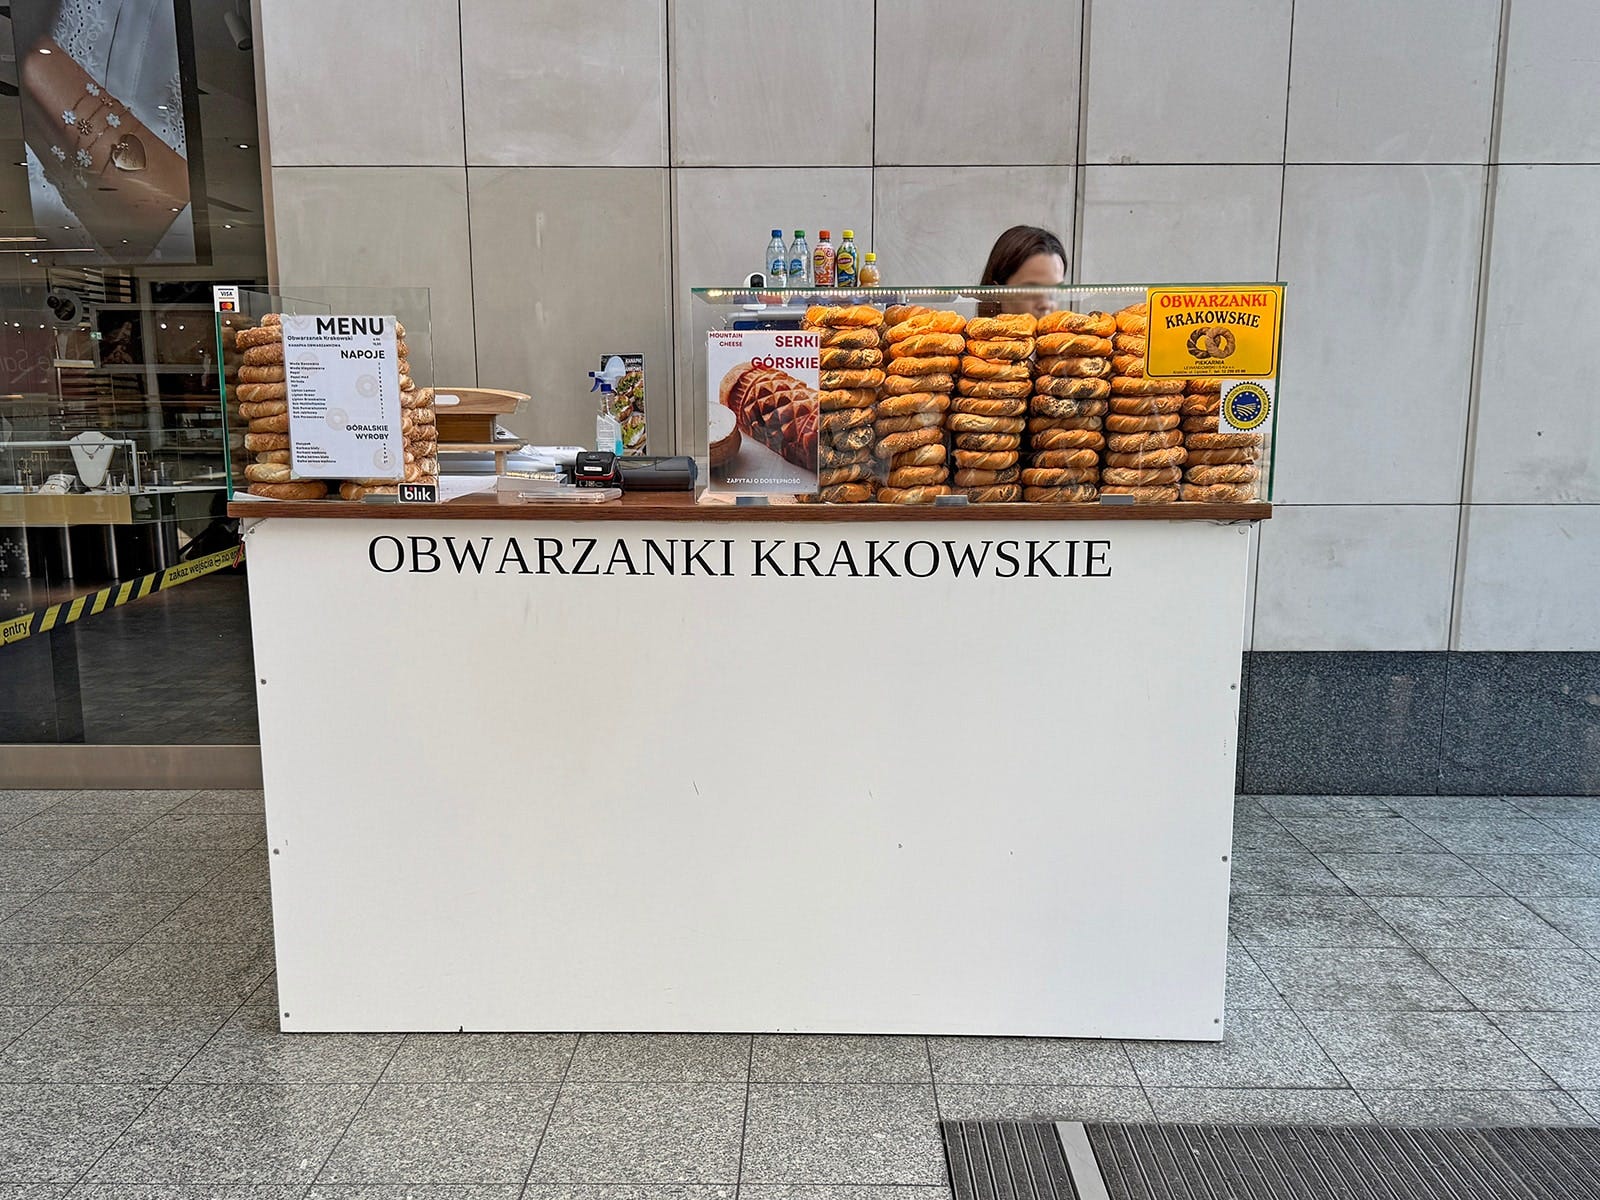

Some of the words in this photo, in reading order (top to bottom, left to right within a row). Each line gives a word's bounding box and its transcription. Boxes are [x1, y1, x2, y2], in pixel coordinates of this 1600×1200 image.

[1160, 294, 1267, 308] OBWARZANKI
[316, 317, 384, 336] MENU
[1165, 311, 1261, 329] KRAKOWSKIE
[775, 335, 818, 348] SERKI
[341, 350, 385, 359] NAPOJE
[751, 353, 819, 369] GÓRSKIE
[346, 424, 389, 432] GÓRALSKIE
[404, 486, 431, 501] blik
[368, 535, 735, 576] OBWARZANKI
[750, 540, 1113, 578] KRAKOWSKIE
[169, 567, 189, 582] zakaz
[189, 558, 214, 573] wejścia
[2, 621, 28, 639] entry
